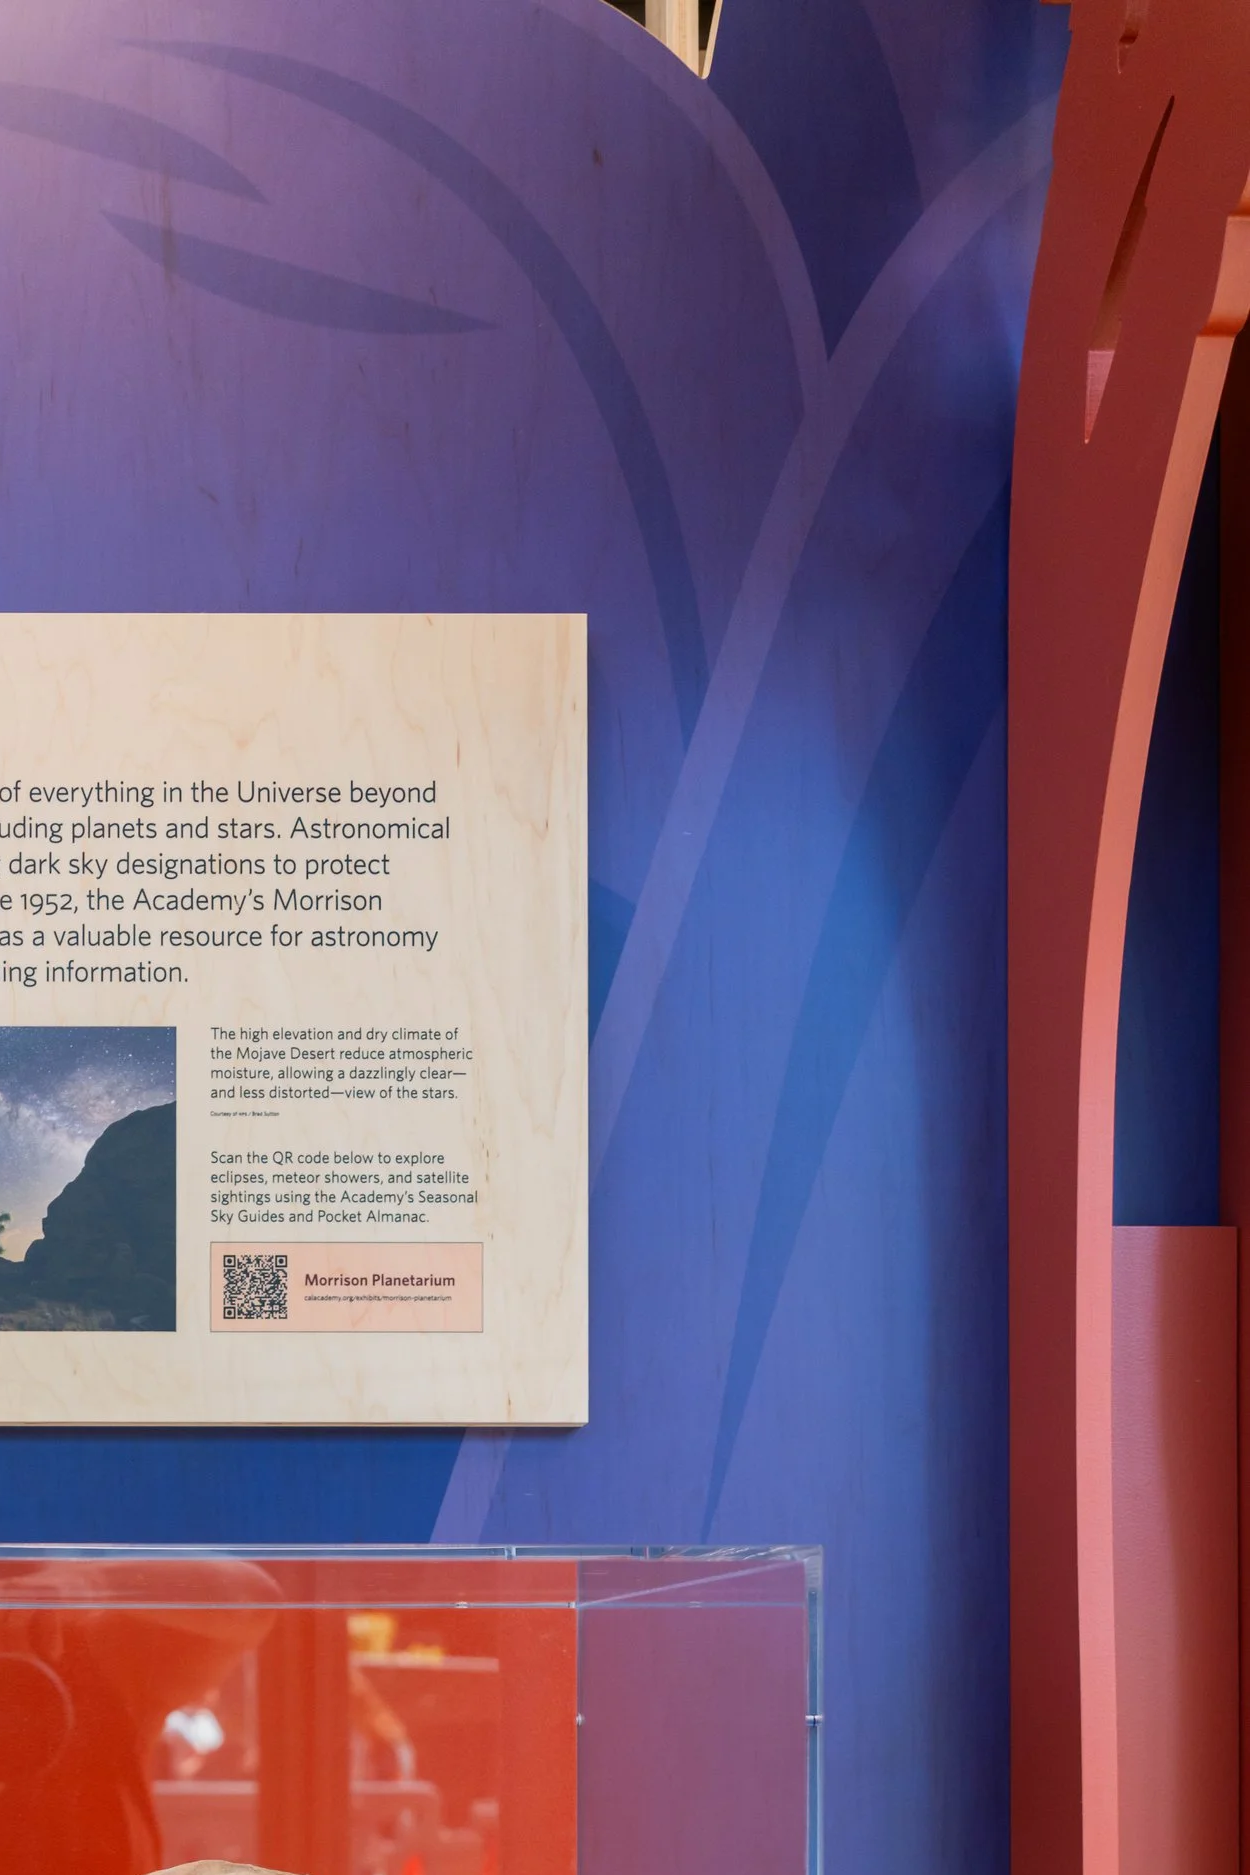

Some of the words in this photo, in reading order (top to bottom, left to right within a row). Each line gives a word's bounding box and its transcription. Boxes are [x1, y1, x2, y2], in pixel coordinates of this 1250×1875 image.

[29, 779, 155, 809] everything
[163, 780, 183, 803] in
[190, 779, 229, 803] the
[237, 780, 342, 804] Universe
[350, 779, 436, 809] beyond
[71, 815, 158, 844] planets
[165, 815, 209, 839] and
[217, 817, 281, 839] stars.
[289, 815, 450, 840] Astronomical
[8, 851, 61, 875] dark
[68, 851, 109, 880] sky
[116, 851, 266, 880] designations
[273, 853, 297, 875] to
[305, 853, 390, 880] protect
[20, 893, 78, 916] 1952,
[86, 887, 125, 911] the
[273, 888, 382, 911] Morrison
[32, 930, 45, 947] a
[53, 923, 152, 947] valuable
[160, 930, 263, 947] resource
[270, 923, 303, 947] for
[310, 925, 439, 953] astronomy
[45, 959, 188, 983] information.
[210, 1026, 236, 1041] The
[240, 1026, 269, 1043] high
[272, 1027, 334, 1041] elevation
[337, 1026, 362, 1041] and
[365, 1027, 388, 1043] dry
[391, 1027, 442, 1041] climate
[445, 1027, 459, 1041] of
[210, 1046, 232, 1060] the
[236, 1046, 286, 1063] Mojave
[290, 1046, 336, 1060] Desert
[339, 1046, 385, 1060] reduce
[388, 1046, 473, 1063] atmospheric
[210, 1066, 274, 1081] moisture,
[277, 1065, 334, 1083] allowing
[337, 1069, 345, 1080] a
[349, 1065, 416, 1083] dazzlingly
[210, 1085, 236, 1099] and
[239, 1085, 266, 1099] less
[379, 1085, 393, 1099] of
[396, 1085, 418, 1099] the
[421, 1087, 458, 1099] stars.
[210, 1150, 243, 1164] Scan
[246, 1150, 269, 1165] the
[272, 1150, 294, 1166] QR
[297, 1151, 330, 1165] code
[333, 1151, 374, 1165] below
[377, 1151, 392, 1165] to
[395, 1151, 445, 1167] explore
[210, 1170, 268, 1187] eclipses,
[272, 1171, 321, 1184] meteor
[324, 1170, 384, 1186] showers,
[387, 1170, 413, 1184] and
[416, 1170, 470, 1184] satellite
[210, 1189, 271, 1206] sightings
[275, 1190, 311, 1206] using
[314, 1189, 337, 1204] the
[418, 1190, 478, 1204] Seasonal
[210, 1209, 234, 1226] Sky
[237, 1209, 285, 1223] Guides
[288, 1209, 314, 1223] and
[317, 1209, 362, 1223] Pocket
[365, 1209, 430, 1223] Almanac.
[304, 1273, 368, 1287] Morrison
[372, 1273, 456, 1287] Planetarium
[303, 1294, 452, 1303] calacademy.org/exhibits/morrison-planetarium
